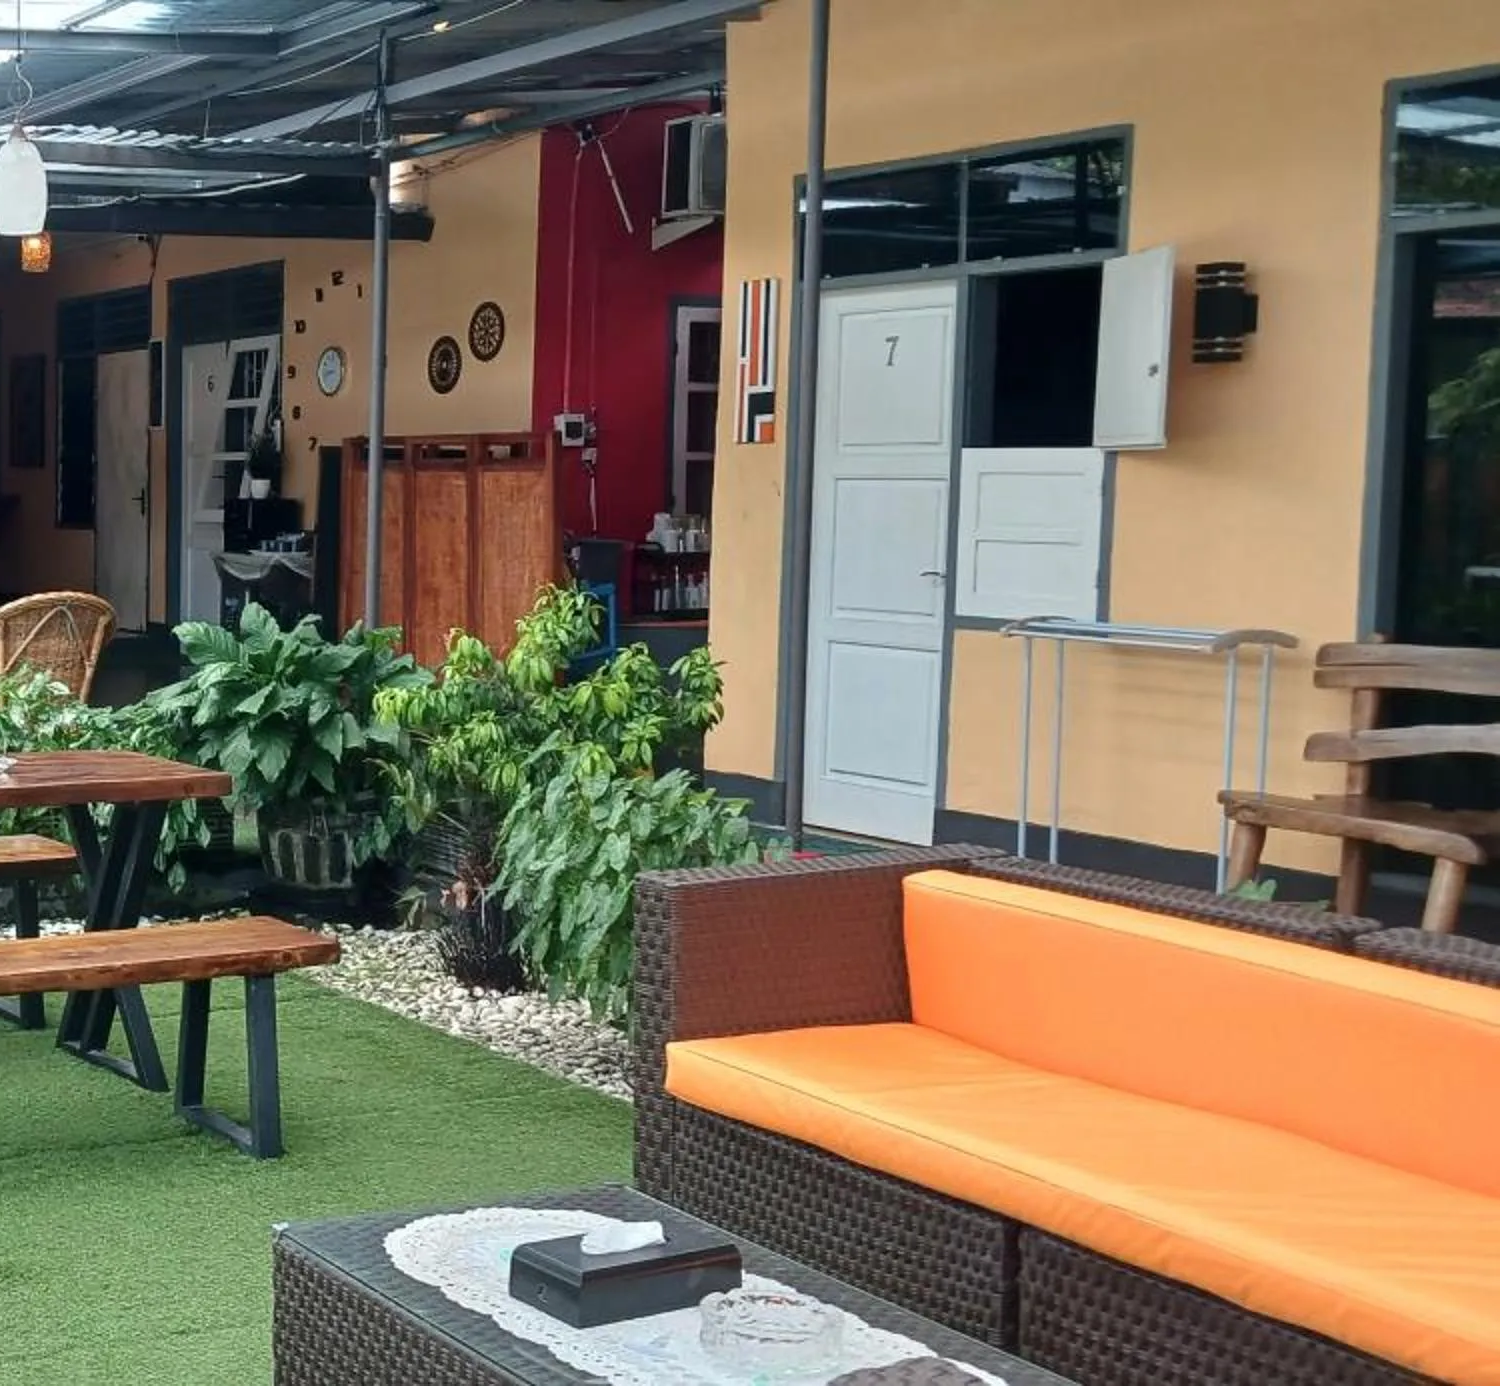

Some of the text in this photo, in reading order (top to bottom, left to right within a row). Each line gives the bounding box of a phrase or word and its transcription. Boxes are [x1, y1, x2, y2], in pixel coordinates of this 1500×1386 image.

[885, 335, 900, 367] 7
[288, 365, 296, 379] 9
[207, 375, 214, 393] 6
[308, 436, 317, 451] 7
